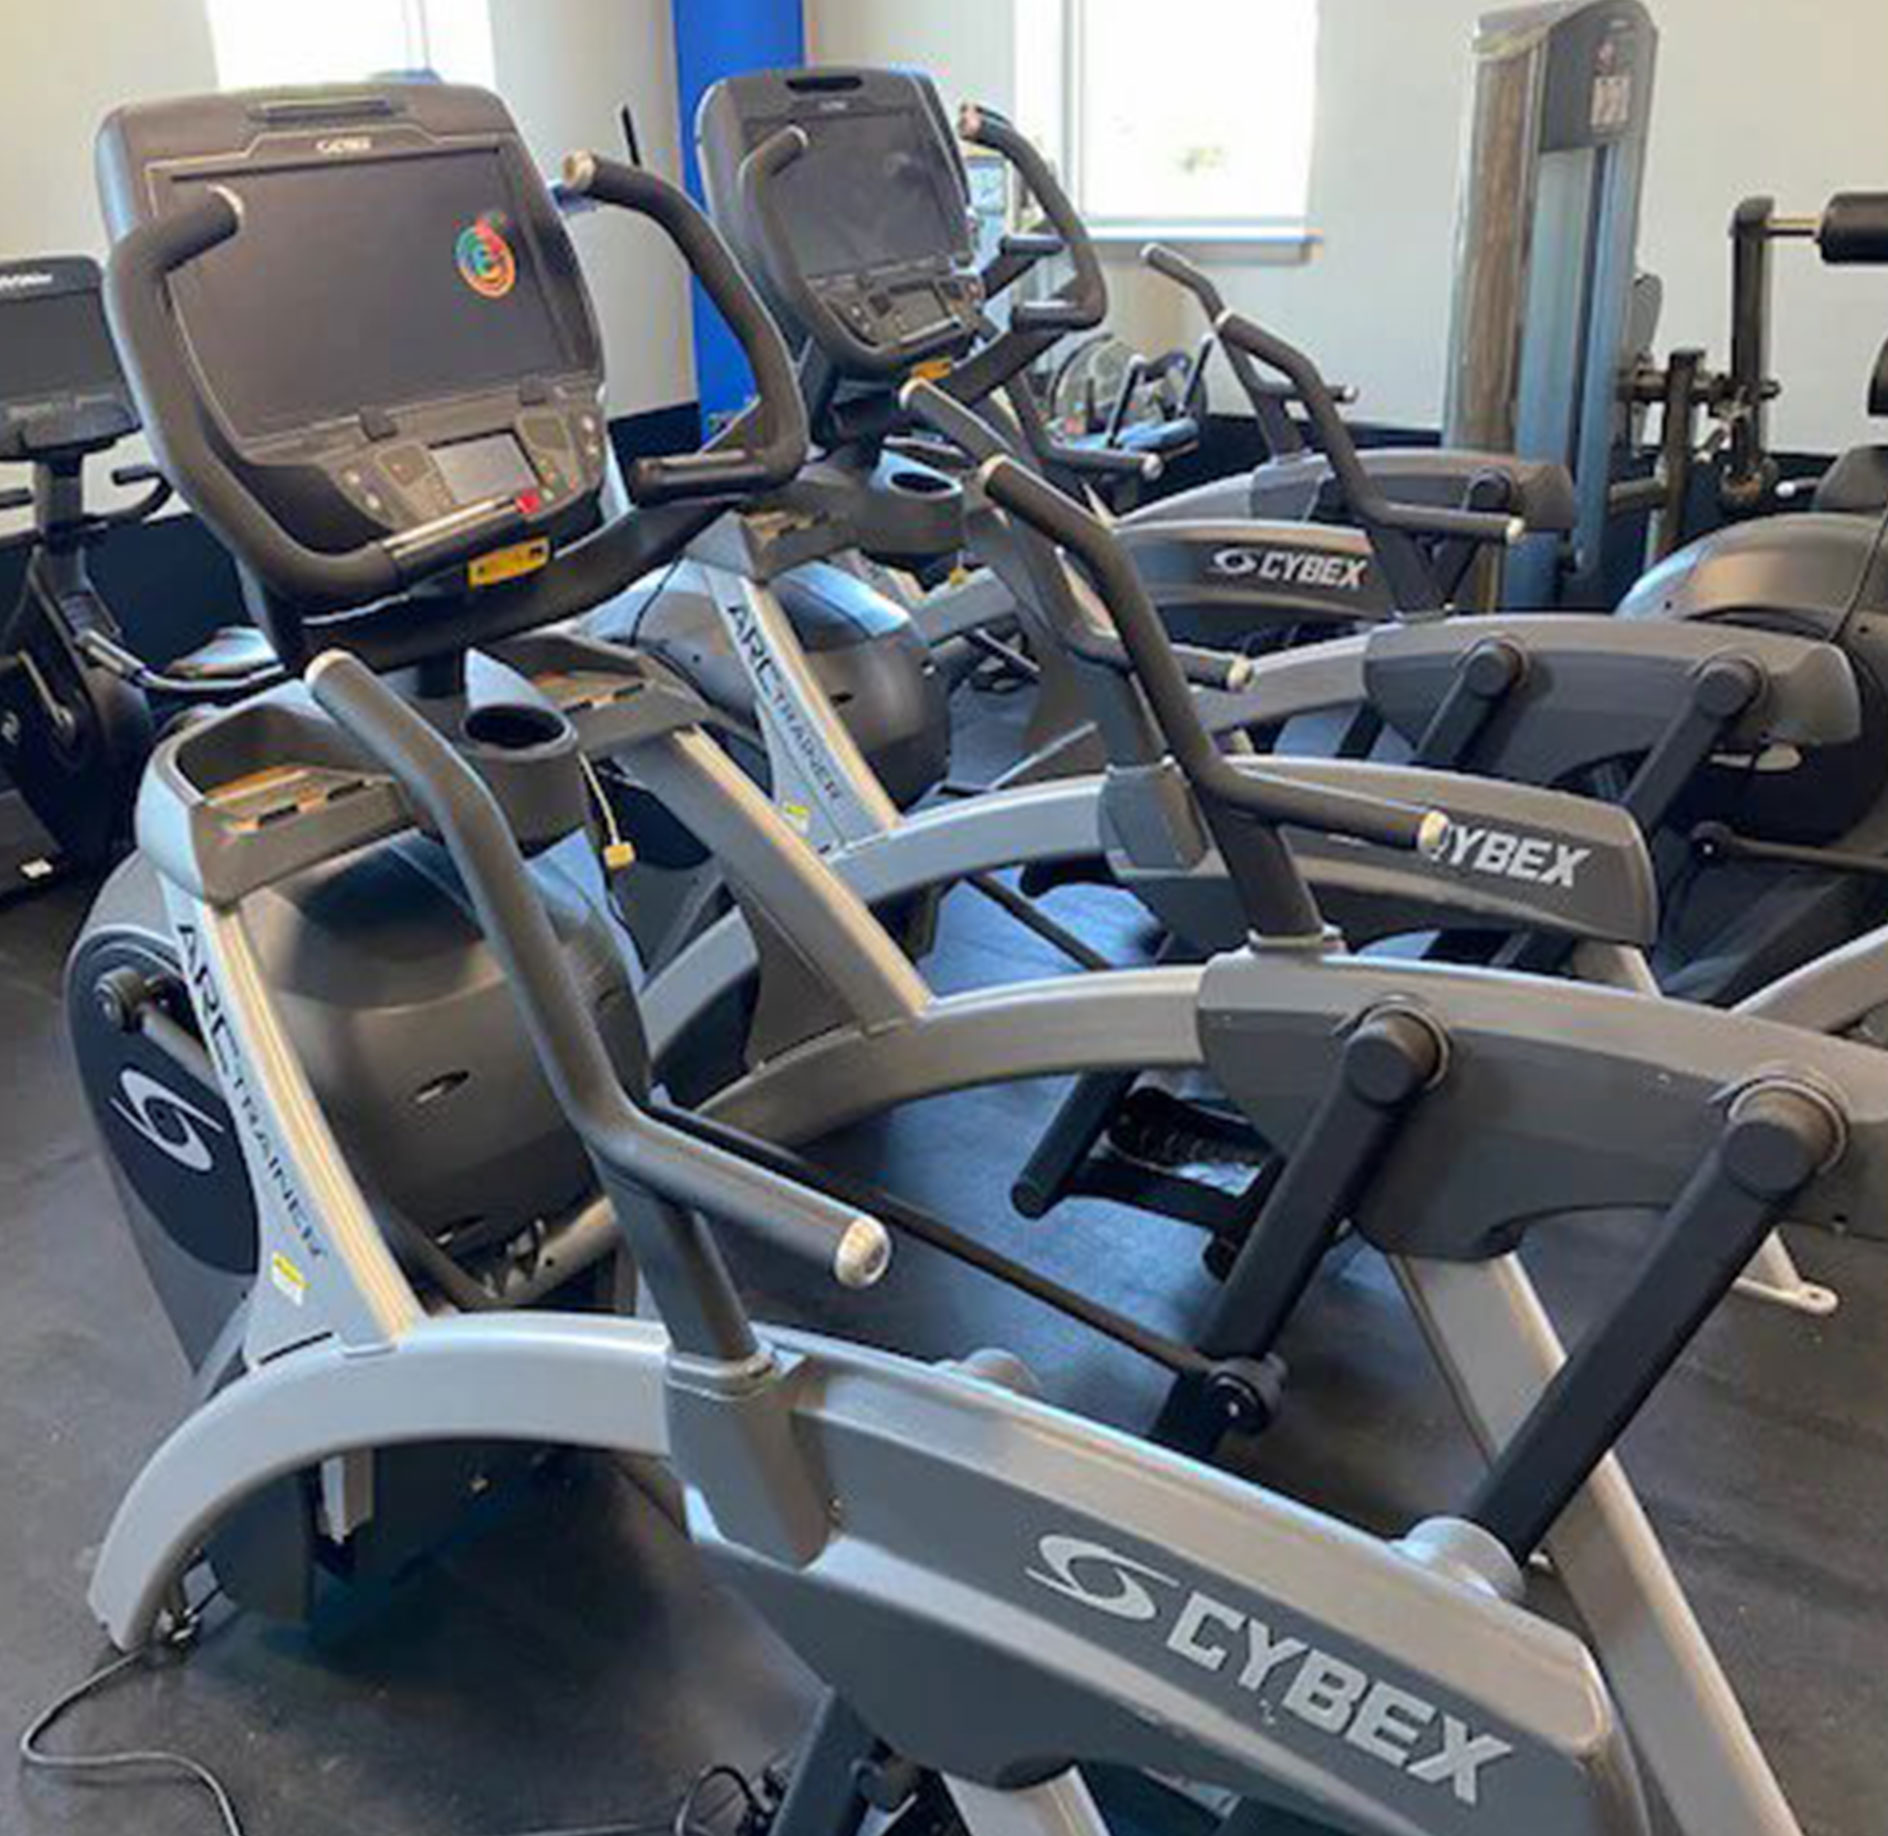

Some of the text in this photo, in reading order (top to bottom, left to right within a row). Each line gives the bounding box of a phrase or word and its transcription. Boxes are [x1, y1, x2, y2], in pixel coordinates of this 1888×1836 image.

[1258, 551, 1368, 591] CYBEX
[727, 605, 783, 695] ARC
[1430, 823, 1593, 888] YBEX
[177, 925, 240, 1074] ARC
[1165, 1591, 1512, 1803] CYBEX
